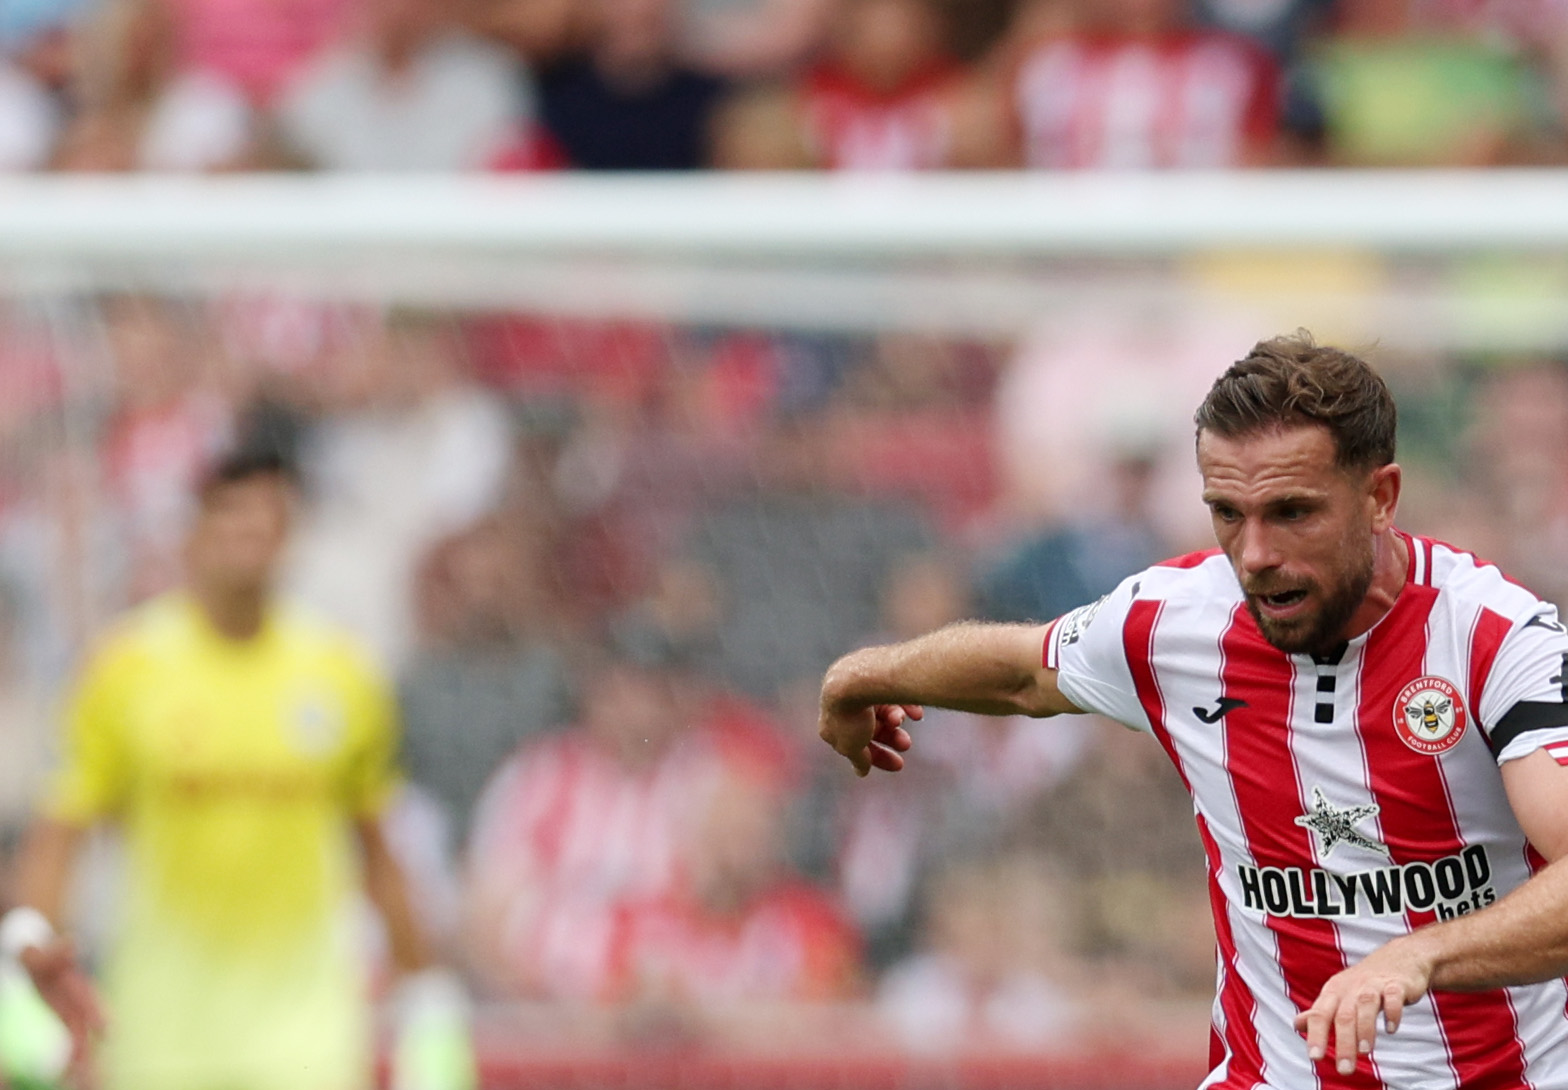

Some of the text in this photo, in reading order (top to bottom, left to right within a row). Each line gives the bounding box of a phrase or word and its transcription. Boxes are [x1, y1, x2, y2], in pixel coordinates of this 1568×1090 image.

[1401, 680, 1453, 703] BRENTFORD
[1408, 727, 1462, 751] FOOTBALL CLUB
[1239, 844, 1491, 915] HOLLYWOOD
